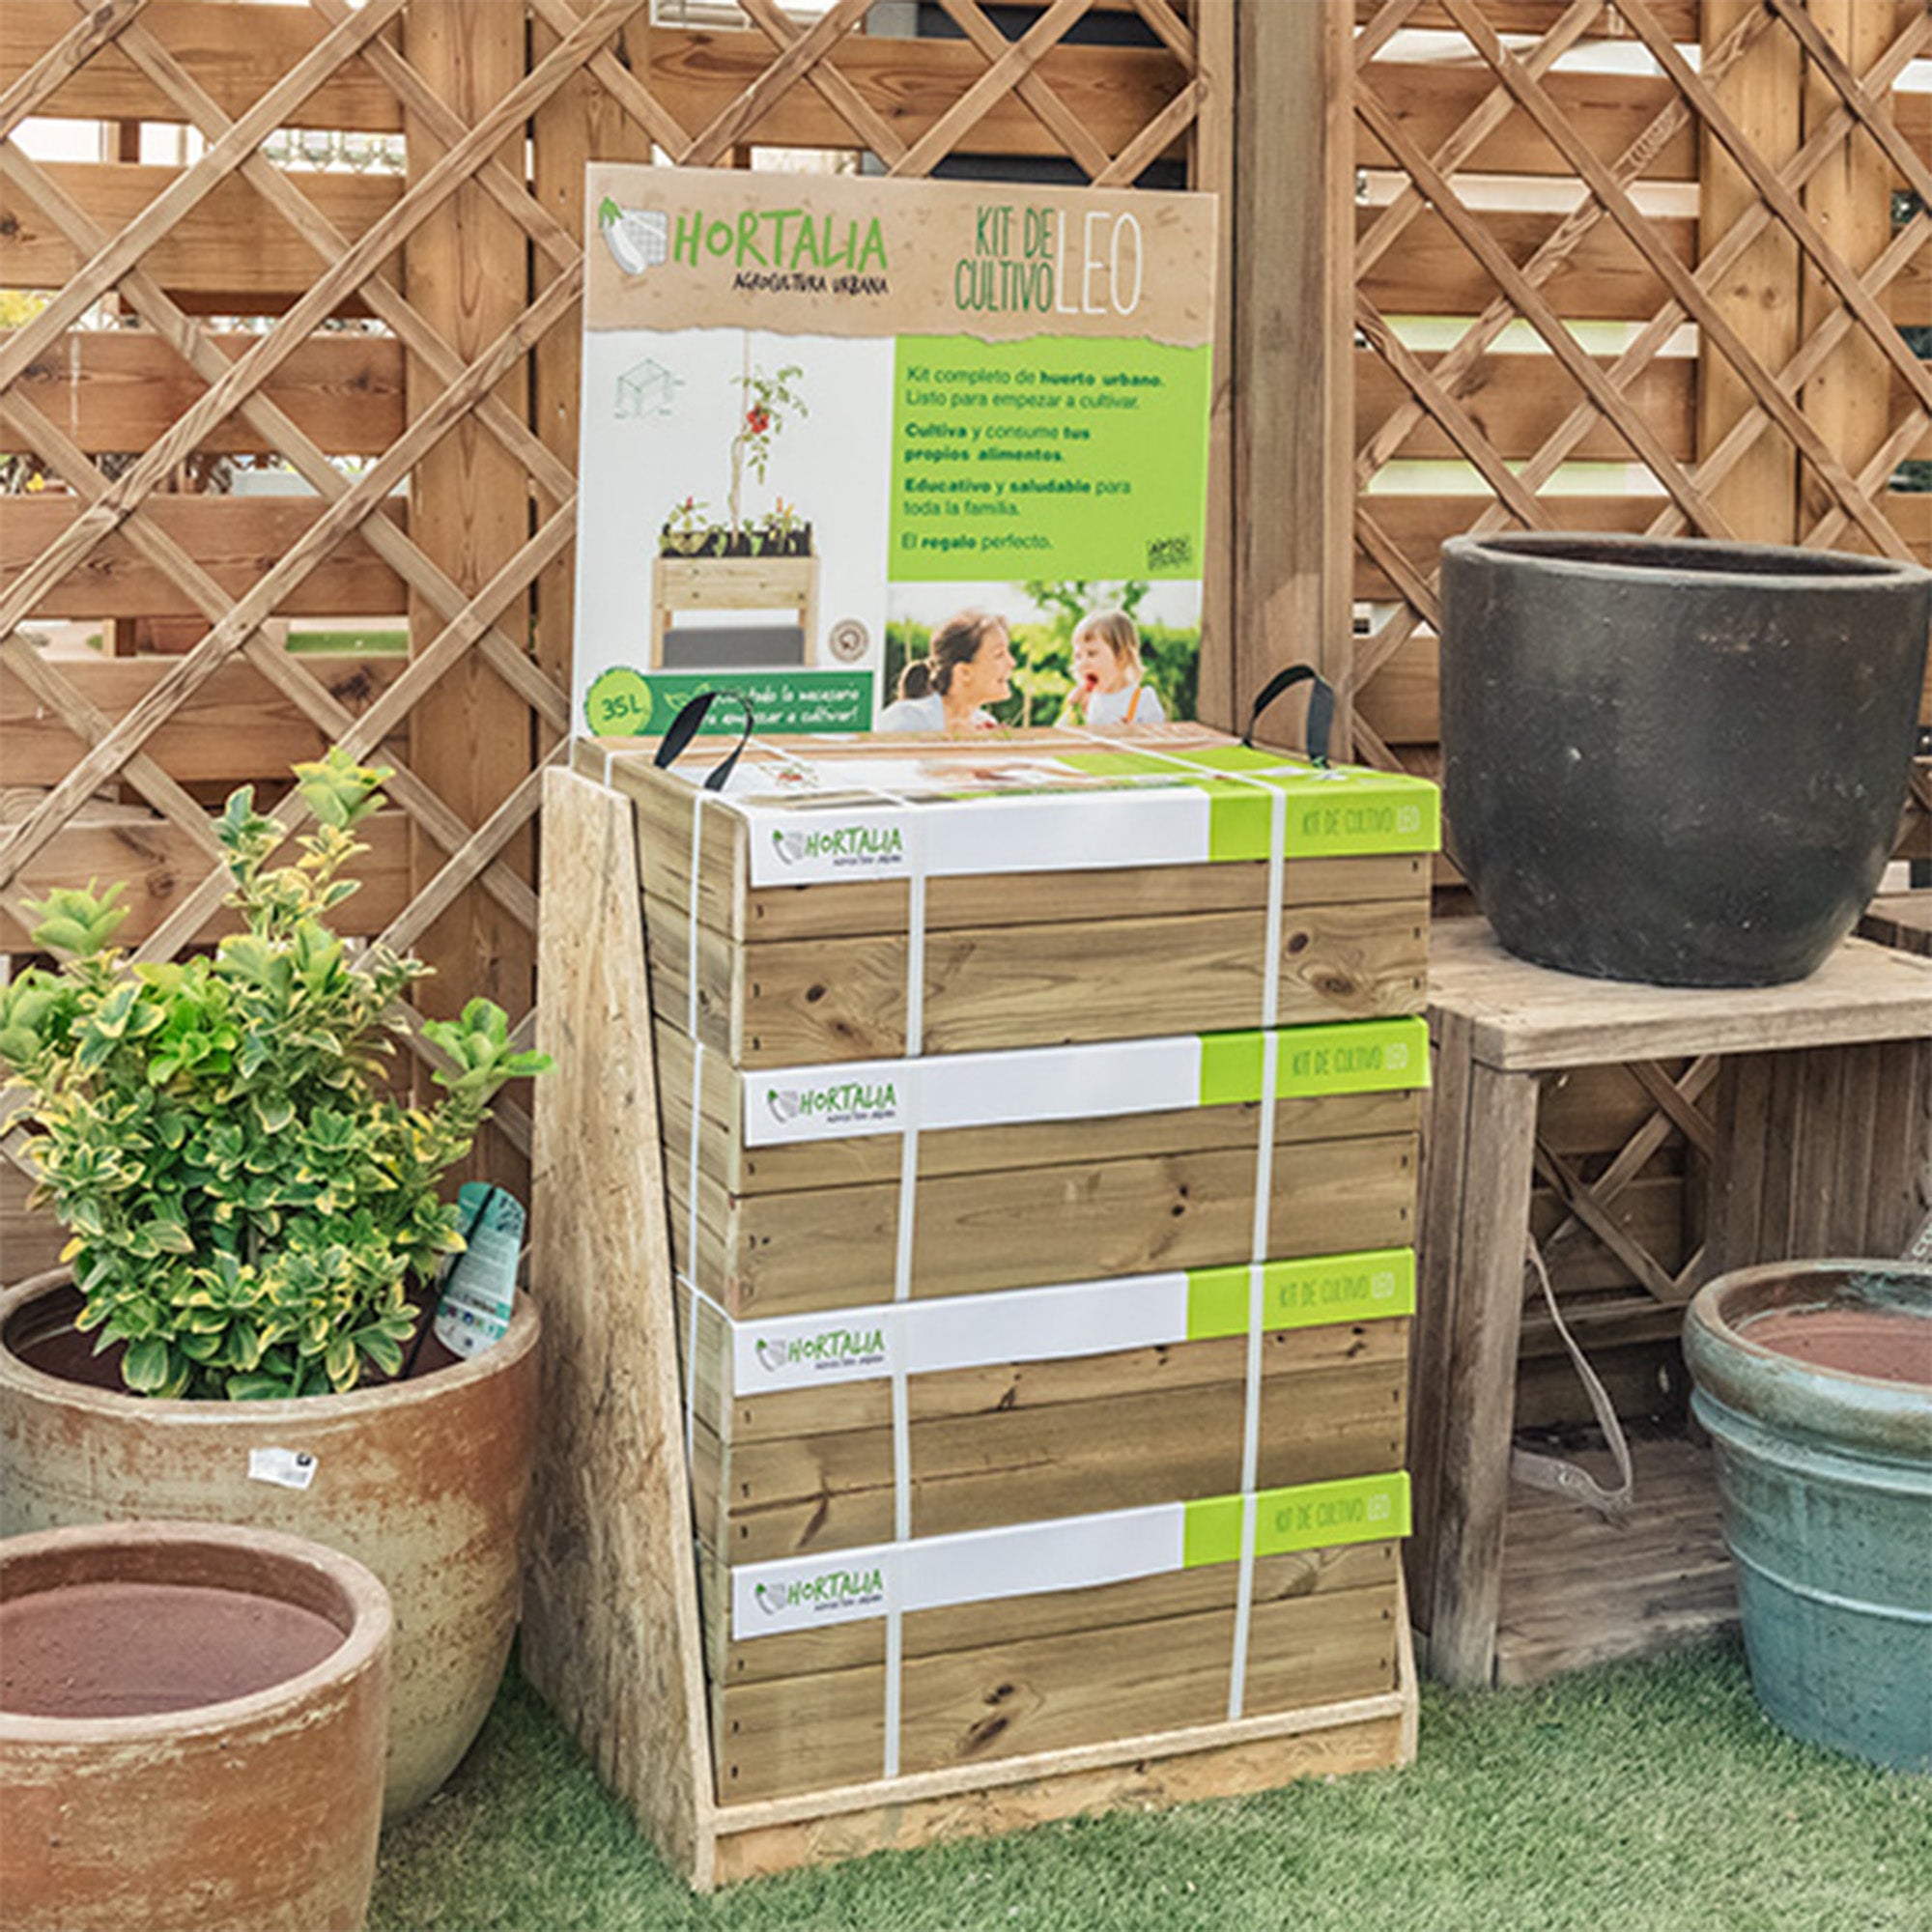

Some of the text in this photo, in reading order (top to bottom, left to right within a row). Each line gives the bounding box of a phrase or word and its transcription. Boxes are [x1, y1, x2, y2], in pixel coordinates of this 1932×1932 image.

[673, 210, 888, 273] HORTALIA
[976, 206, 1055, 259] KIT DE
[1056, 210, 1143, 315] LEO
[954, 258, 1054, 313] CULTIVO
[906, 366, 930, 384] Kit
[933, 368, 1011, 386] completo
[1013, 369, 1037, 385] de
[1039, 370, 1095, 385] huerto
[906, 389, 1140, 410] Listo para empezar a cultivar.
[905, 422, 1091, 441] Cultiva y consume tus
[904, 445, 969, 464] propios
[904, 477, 1131, 497] Educativo y saludable para
[903, 500, 1021, 516] toda la familia.
[901, 532, 1053, 552] El regalo perfecto.
[782, 684, 794, 702] lo
[806, 825, 903, 858] HORTALIA
[799, 1081, 896, 1115] HORTALIA
[788, 1328, 885, 1363] HORTALIA
[786, 1569, 883, 1605] HORTALIA
